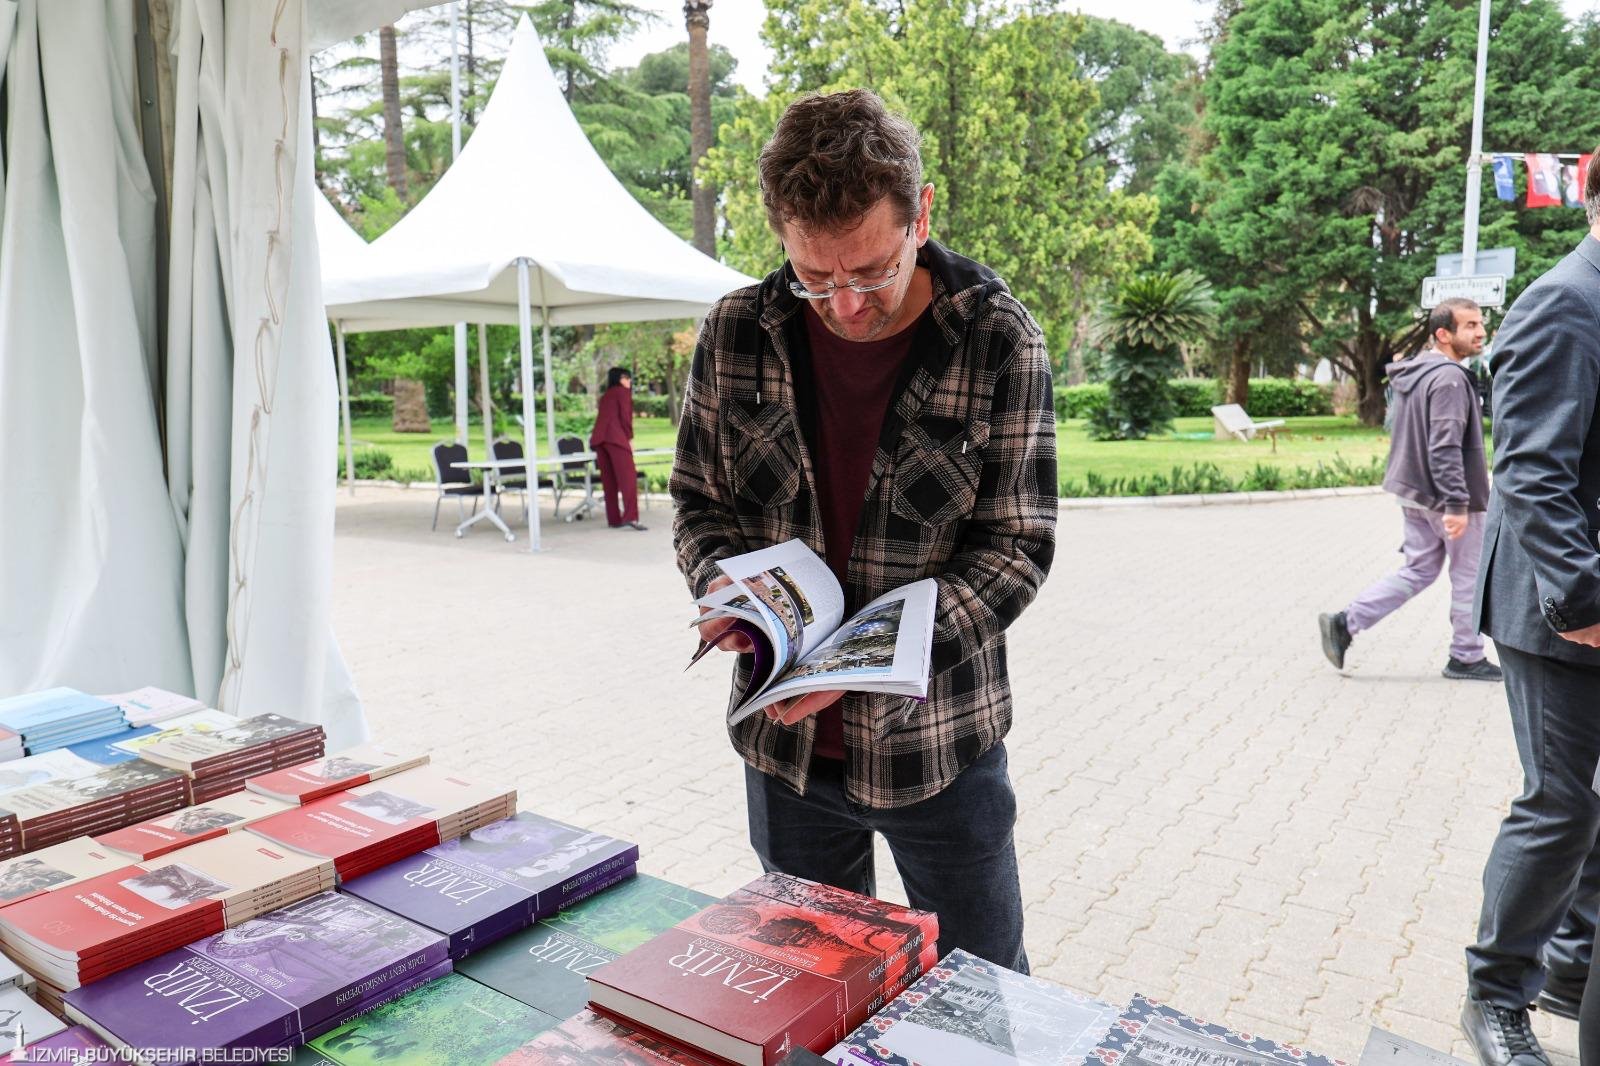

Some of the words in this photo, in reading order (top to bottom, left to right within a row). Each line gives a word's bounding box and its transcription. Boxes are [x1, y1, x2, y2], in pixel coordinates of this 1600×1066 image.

[403, 863, 496, 905] İZMİR
[529, 936, 611, 980] ZMİR
[693, 937, 772, 967] ANSİKLOPEDİSİ
[769, 949, 816, 969] Ekonomi
[669, 943, 792, 1004] İZMİR
[769, 963, 802, 978] KENT
[144, 962, 249, 1025] İZMİR
[235, 980, 264, 1000] KENT
[335, 971, 388, 1006] ANSİKLOPEDİSİ
